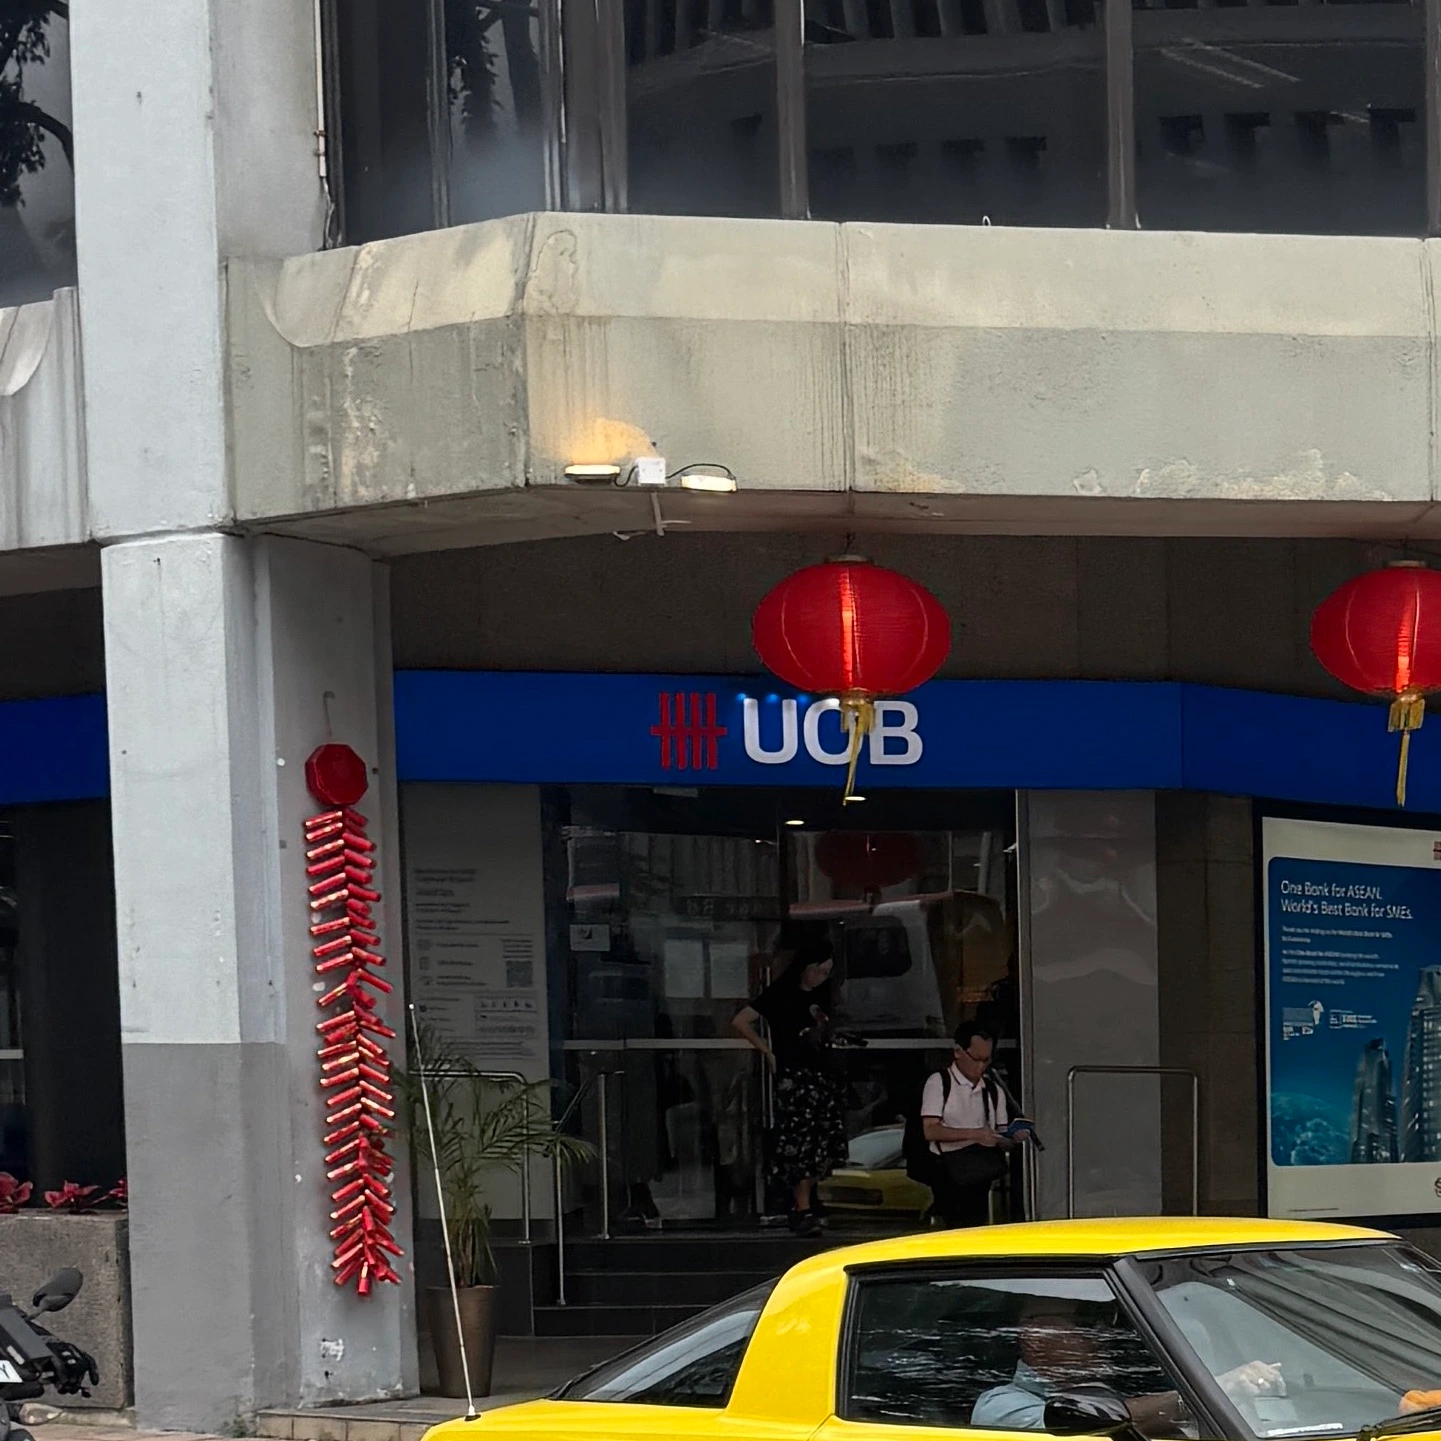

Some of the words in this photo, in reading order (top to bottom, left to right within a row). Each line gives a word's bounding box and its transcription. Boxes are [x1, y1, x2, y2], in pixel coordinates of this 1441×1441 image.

[743, 698, 923, 765] UOB
[1281, 880, 1302, 895] One
[1304, 882, 1329, 897] Bank
[1331, 883, 1345, 897] for
[1281, 898, 1318, 914] World's
[1321, 901, 1343, 916] Best
[1345, 902, 1368, 917] Bank
[1370, 903, 1384, 917] for
